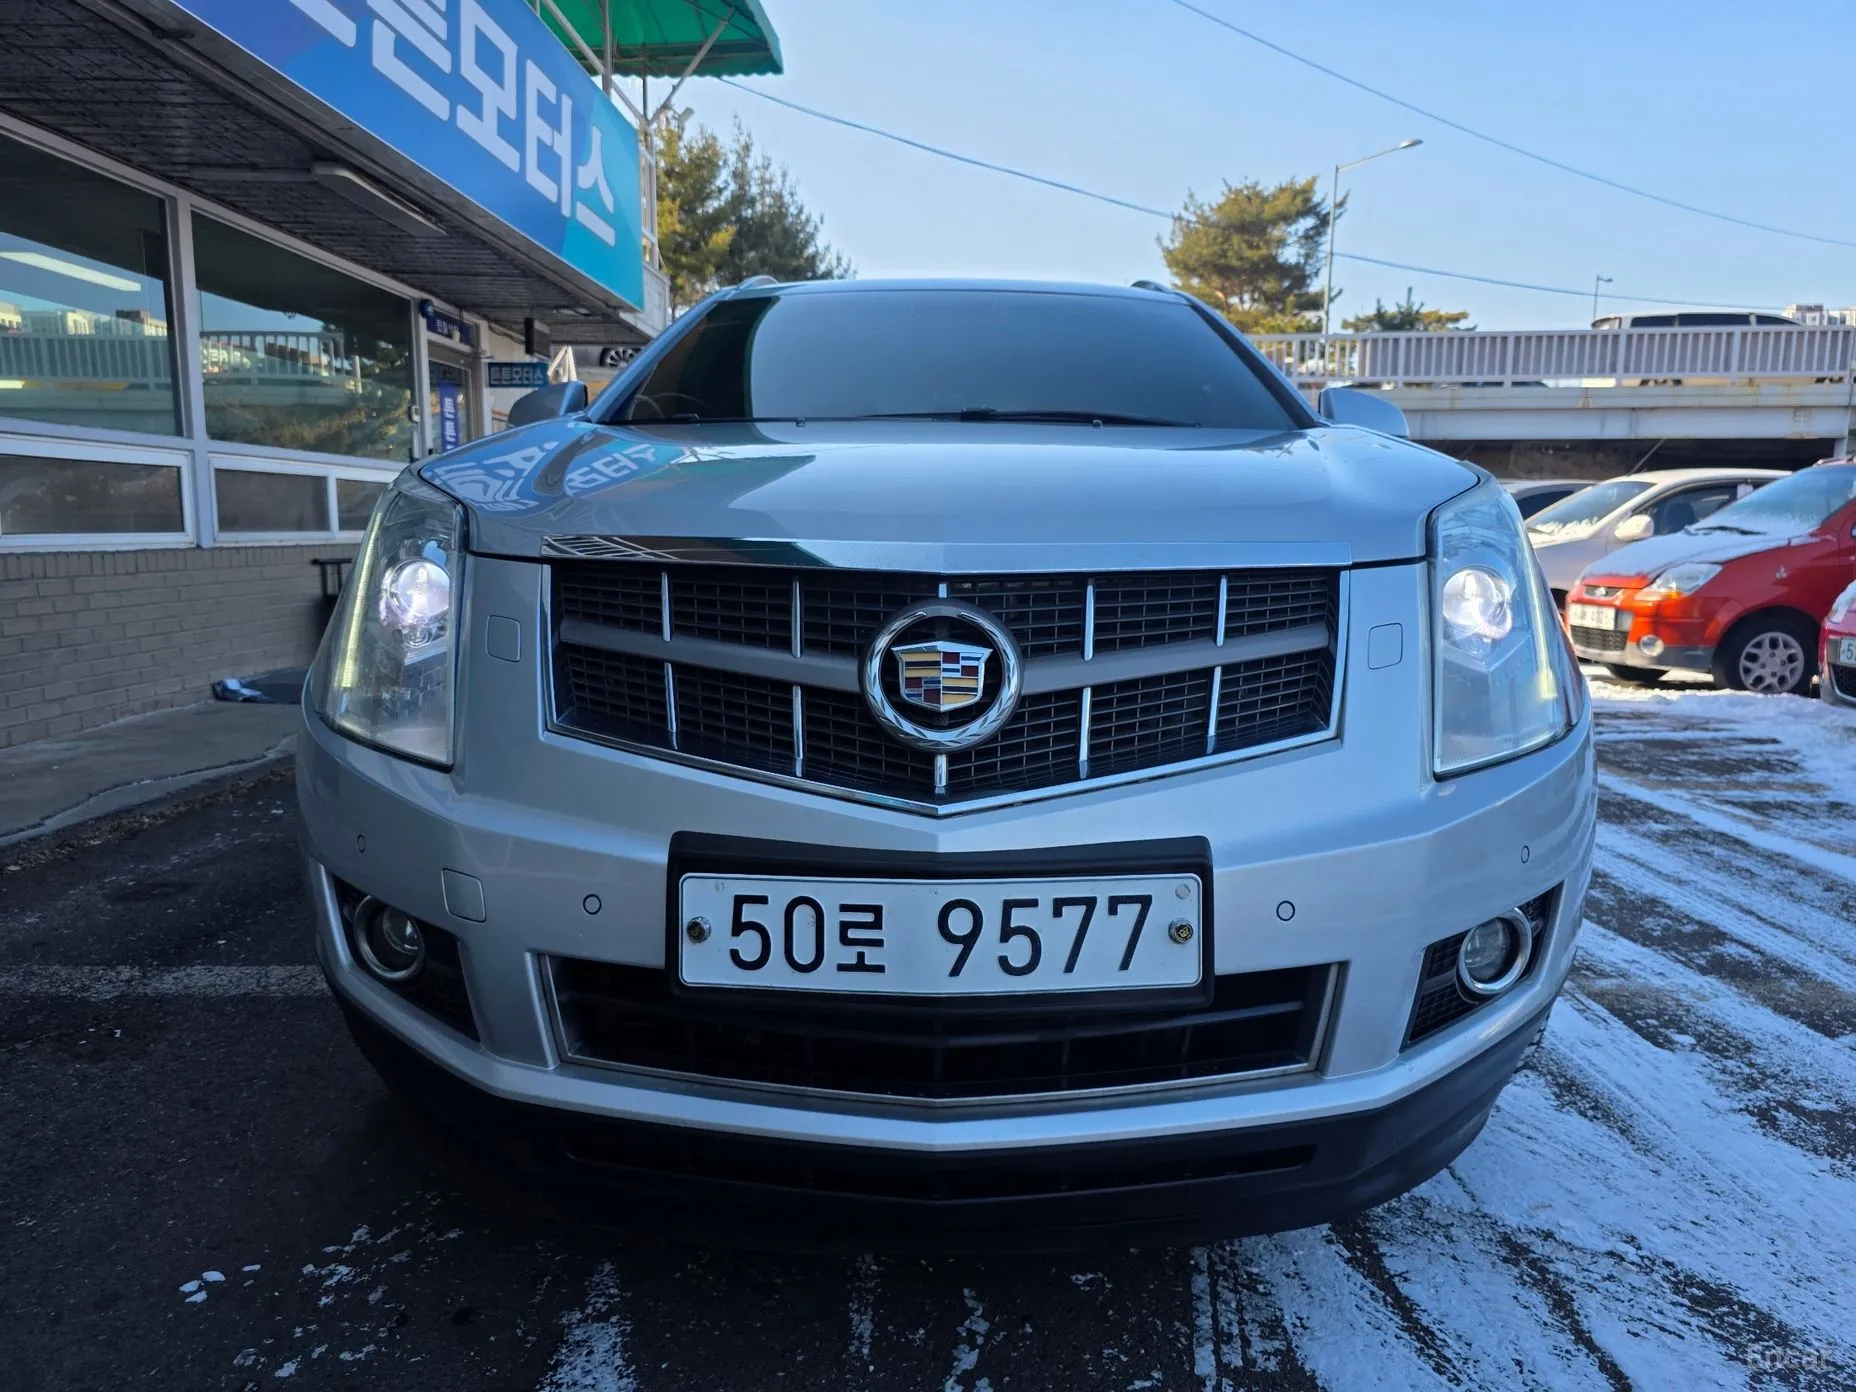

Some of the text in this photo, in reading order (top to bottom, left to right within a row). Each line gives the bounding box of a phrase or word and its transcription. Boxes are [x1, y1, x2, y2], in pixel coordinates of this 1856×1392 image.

[290, 0, 616, 248] 튼모터스
[729, 894, 1153, 977] 50로 9577
